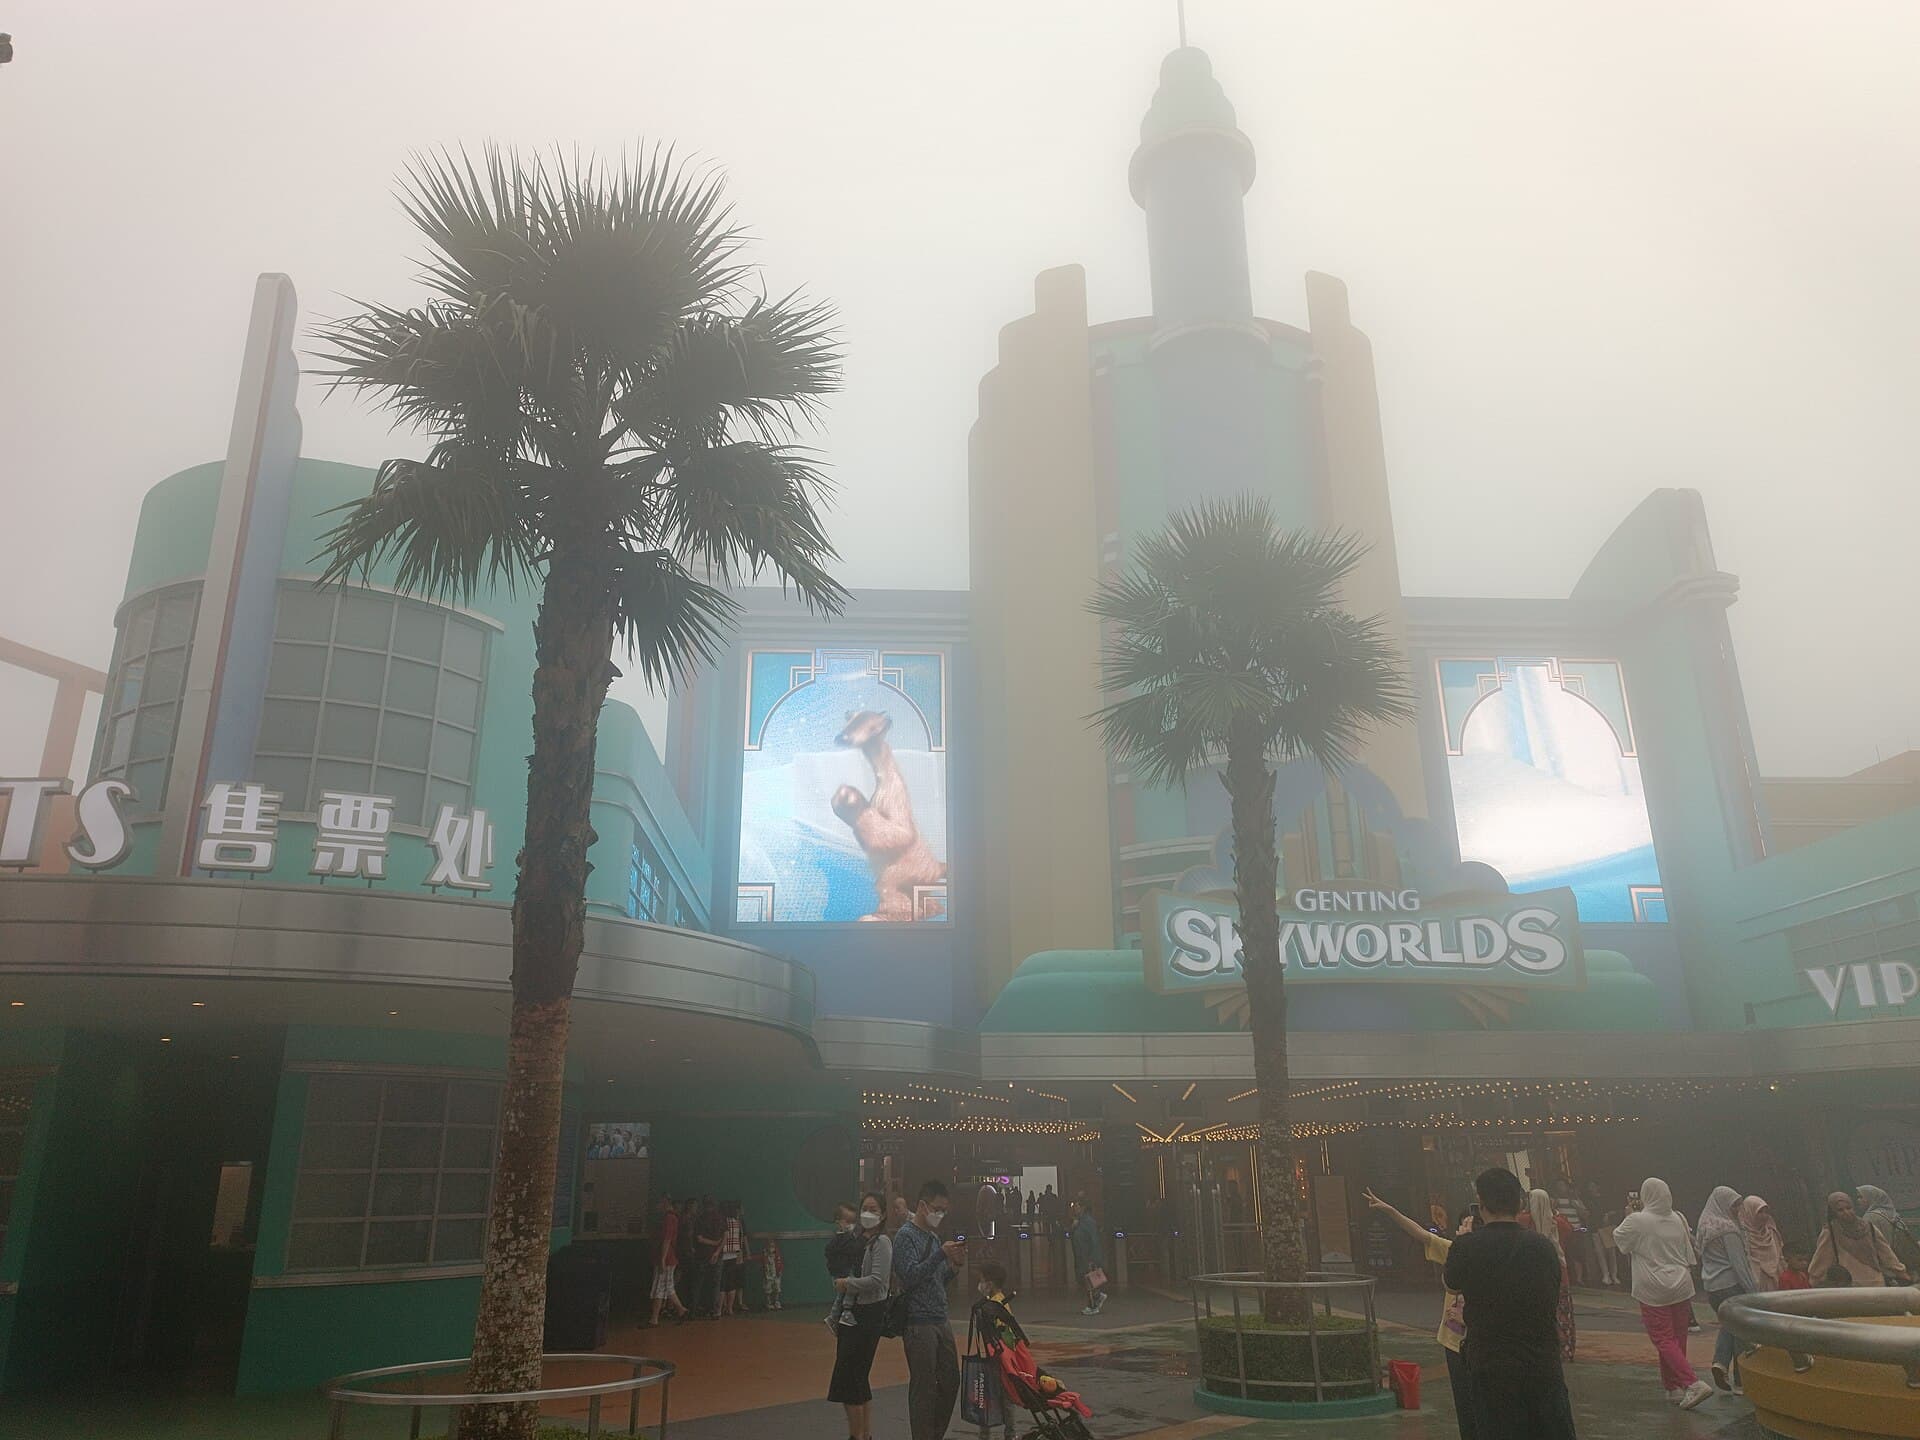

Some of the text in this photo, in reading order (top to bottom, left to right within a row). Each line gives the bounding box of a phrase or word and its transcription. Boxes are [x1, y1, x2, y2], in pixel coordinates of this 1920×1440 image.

[197, 781, 495, 891] 售票处
[1295, 888, 1420, 912] GENTING
[1805, 961, 1919, 1013] VIP
